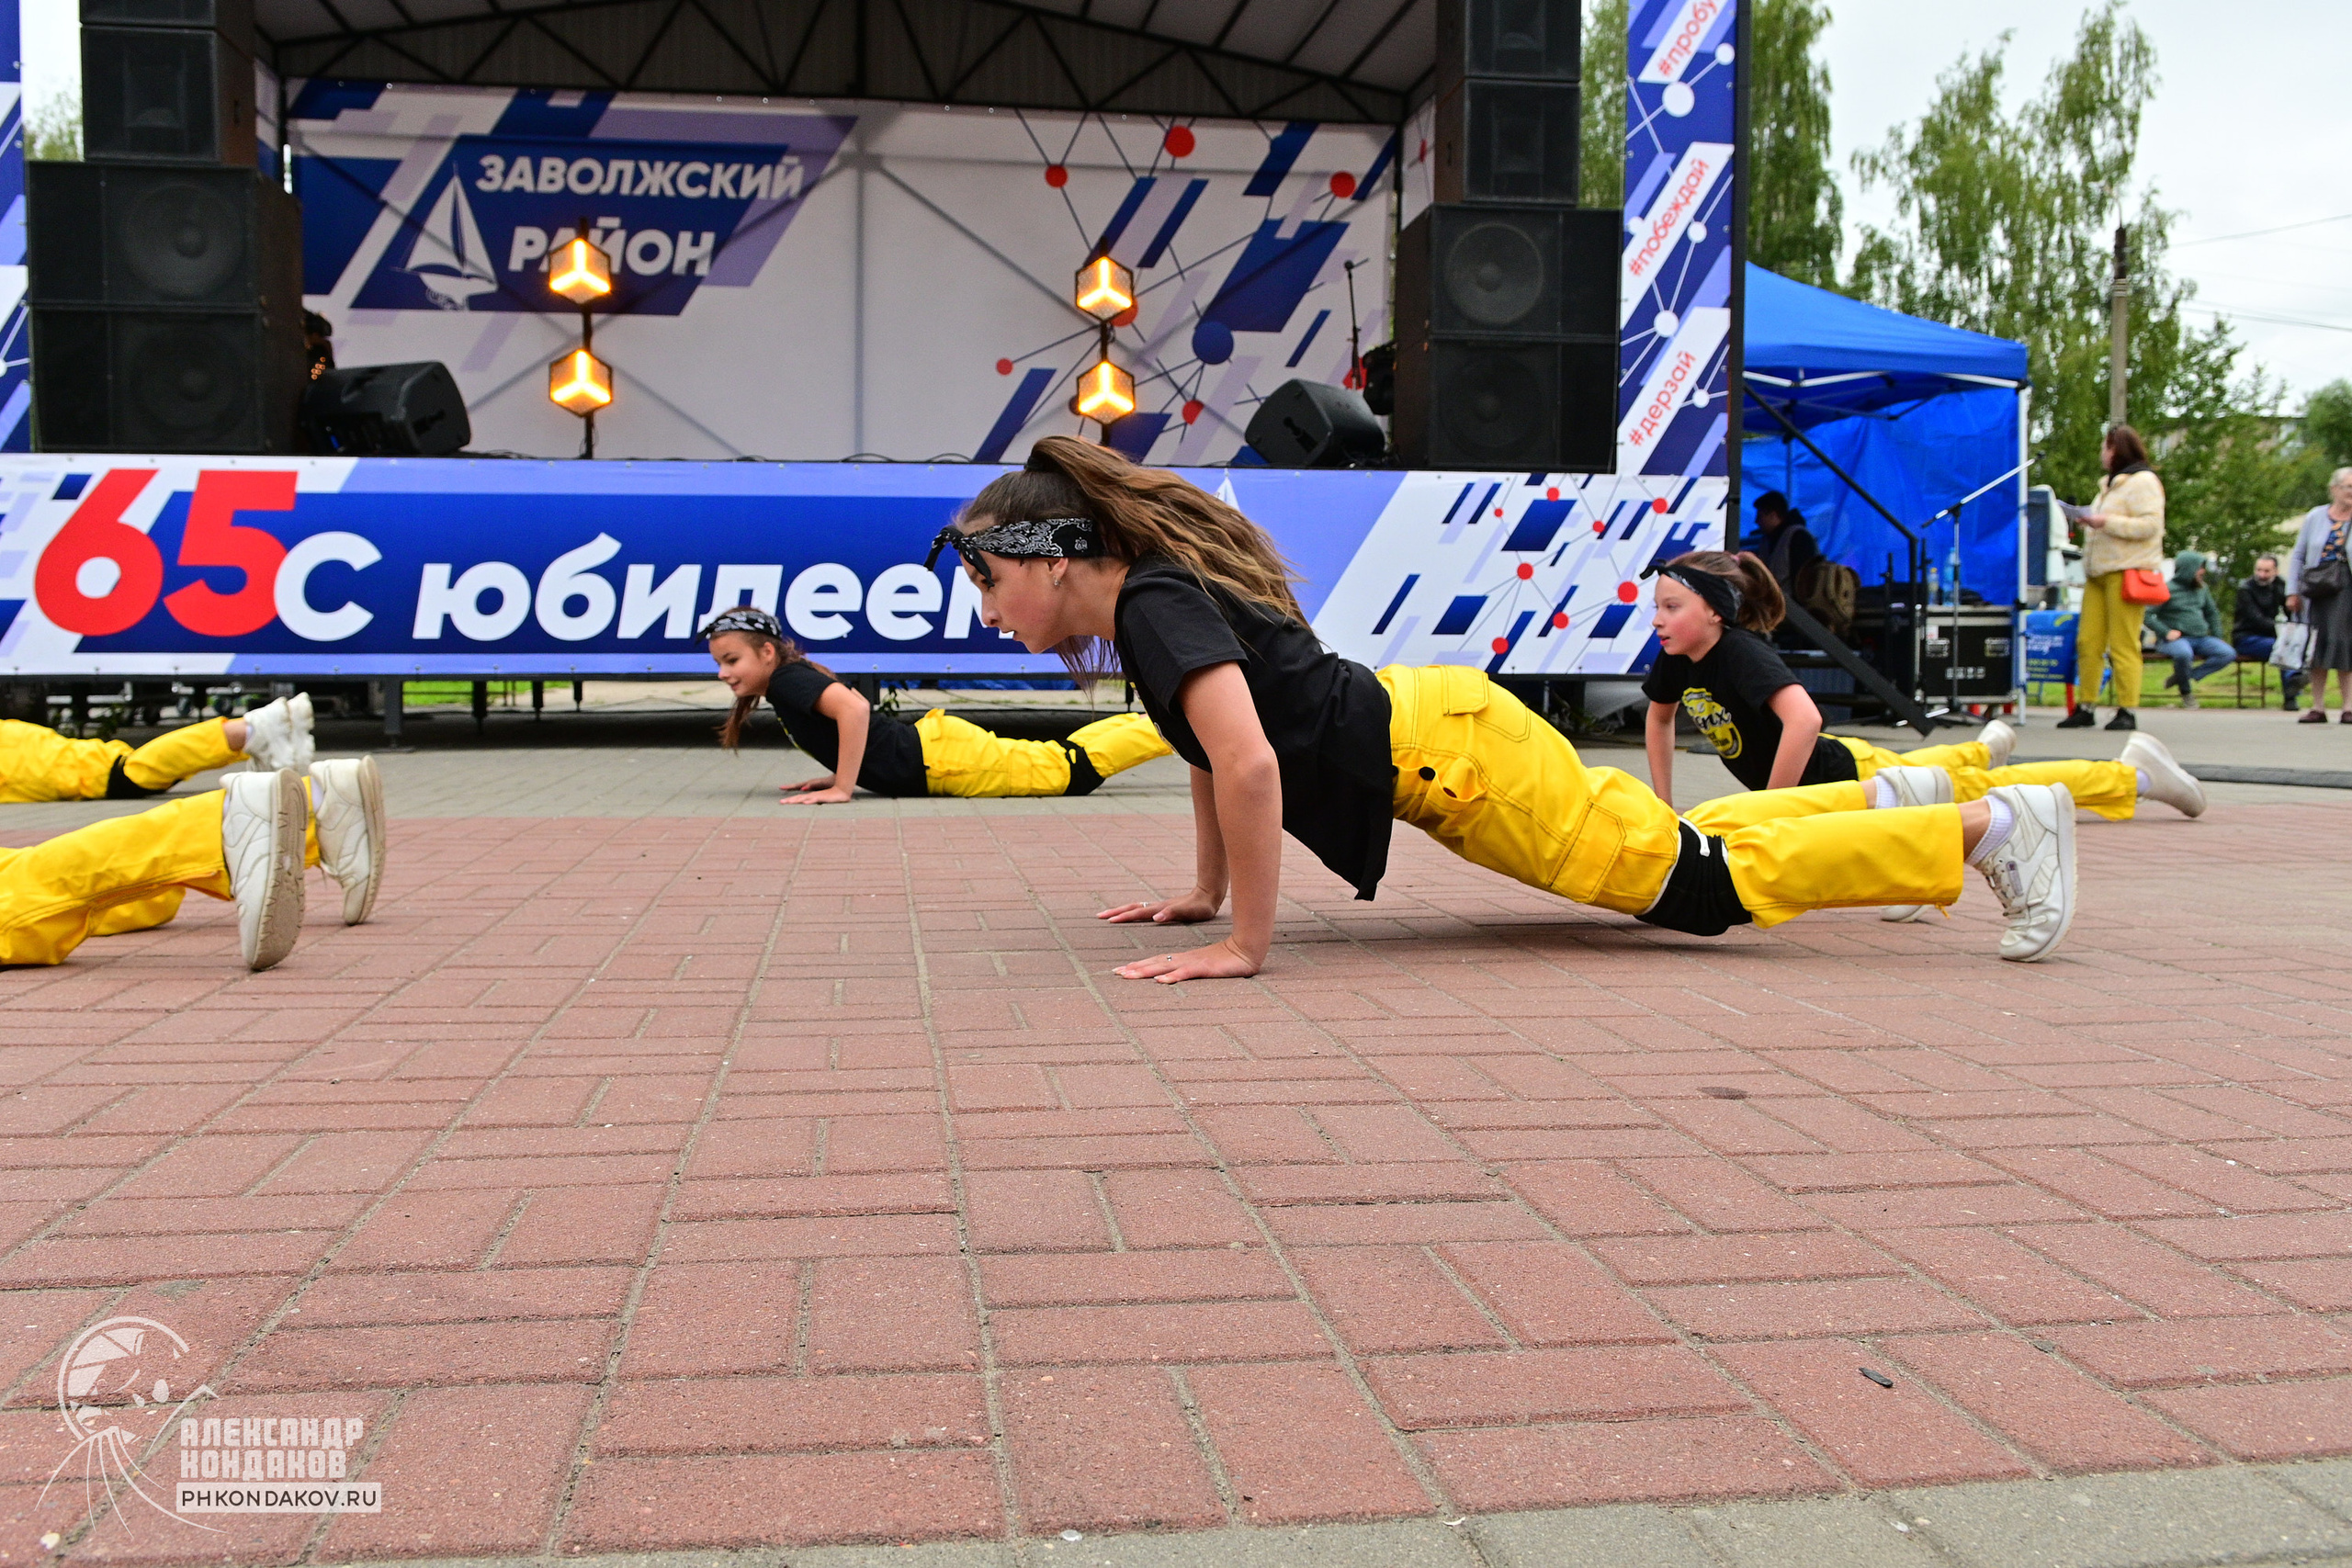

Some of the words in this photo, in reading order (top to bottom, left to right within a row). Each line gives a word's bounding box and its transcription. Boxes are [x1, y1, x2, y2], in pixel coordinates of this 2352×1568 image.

[475, 154, 805, 199] ЗАВОЛЖСКИЙ
[1629, 158, 1710, 276] #побеждай
[1629, 351, 1696, 446] #дерзай
[33, 468, 299, 637] 65
